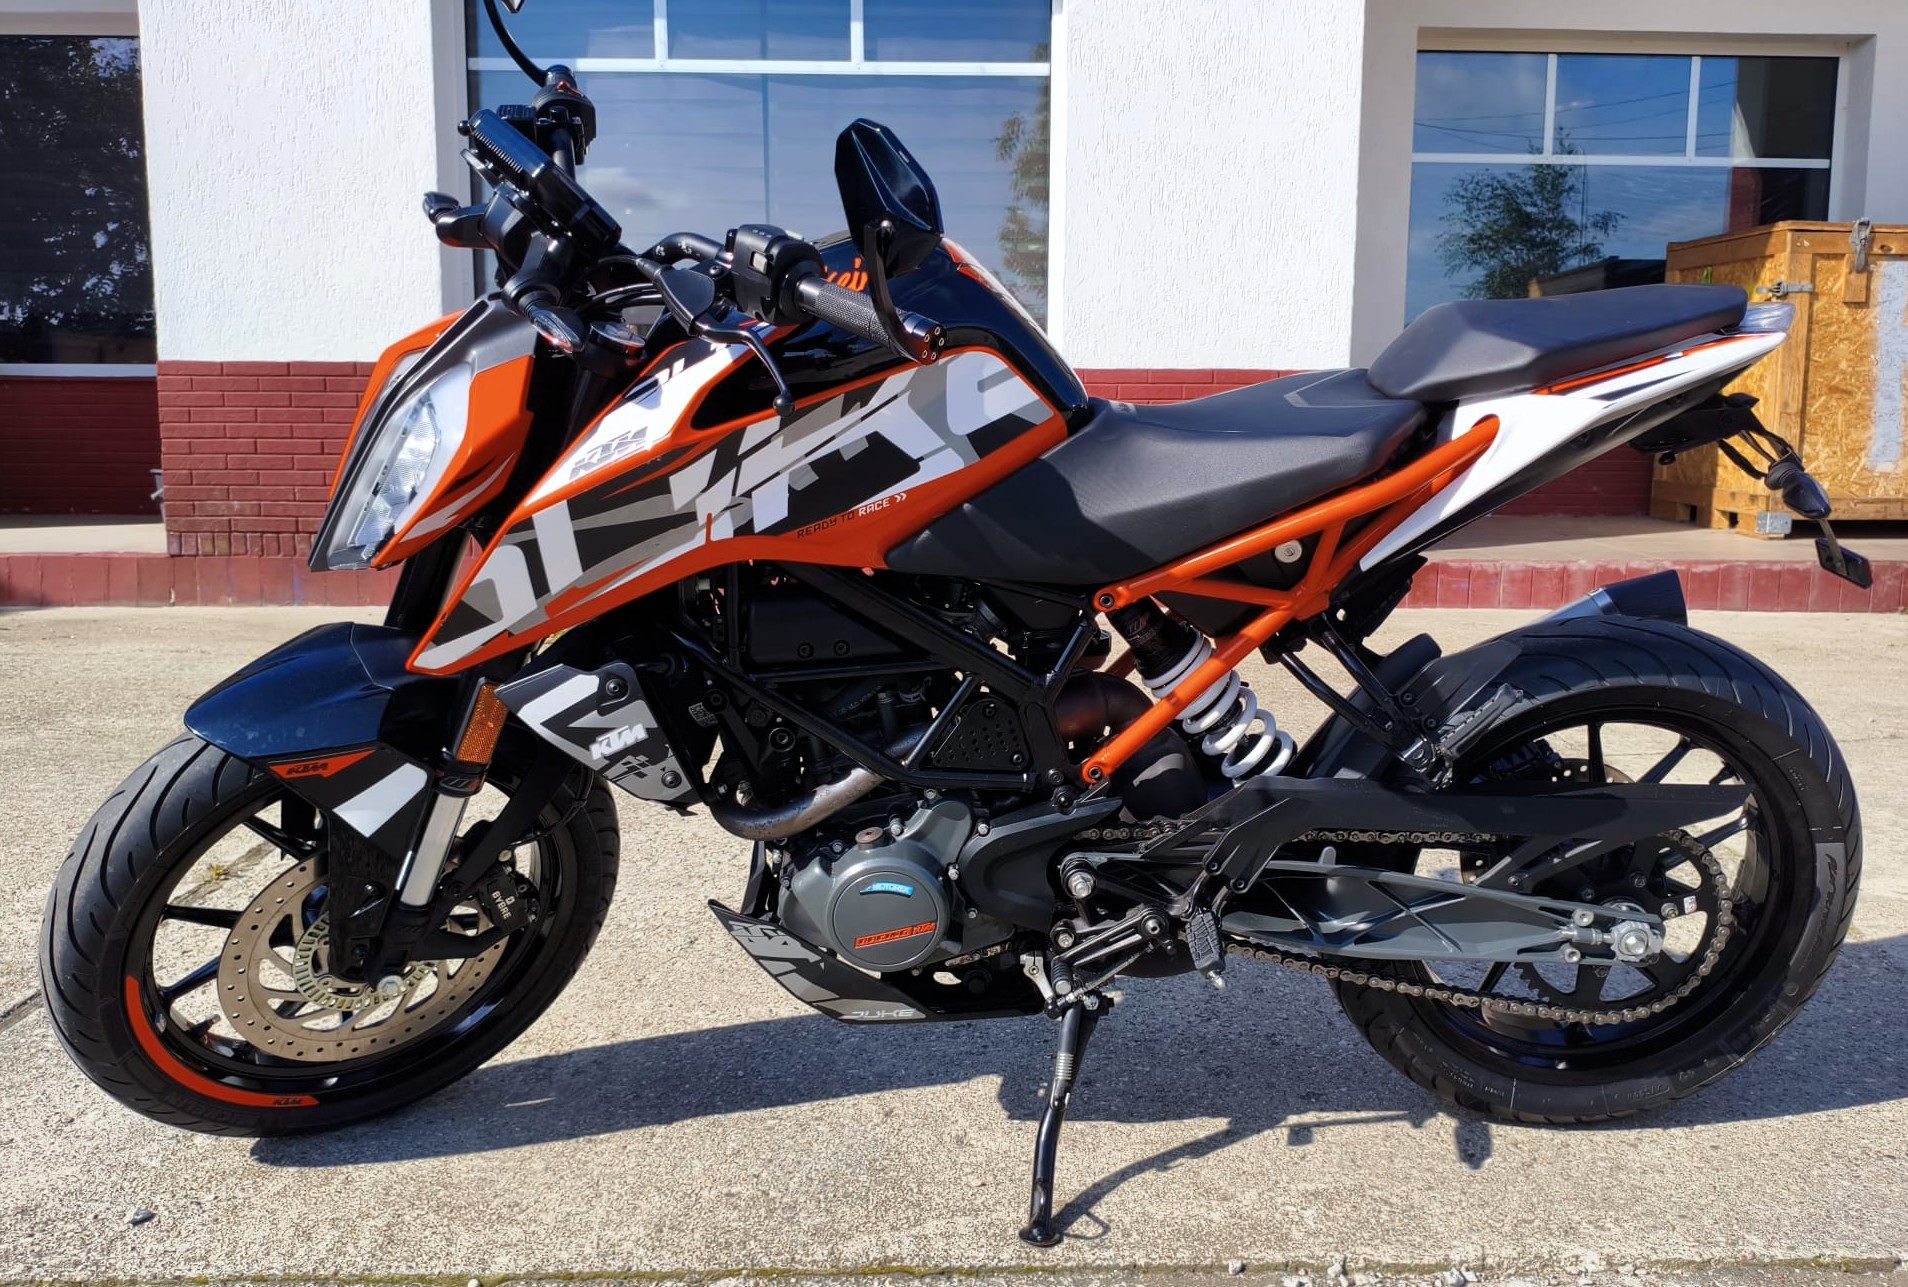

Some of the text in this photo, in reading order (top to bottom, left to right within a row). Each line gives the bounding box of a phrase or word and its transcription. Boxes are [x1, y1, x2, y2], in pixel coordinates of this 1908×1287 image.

[796, 497, 891, 538] READY TO RACE
[589, 723, 649, 760] KTM
[286, 763, 329, 775] KTM
[491, 890, 512, 920] BYBRE
